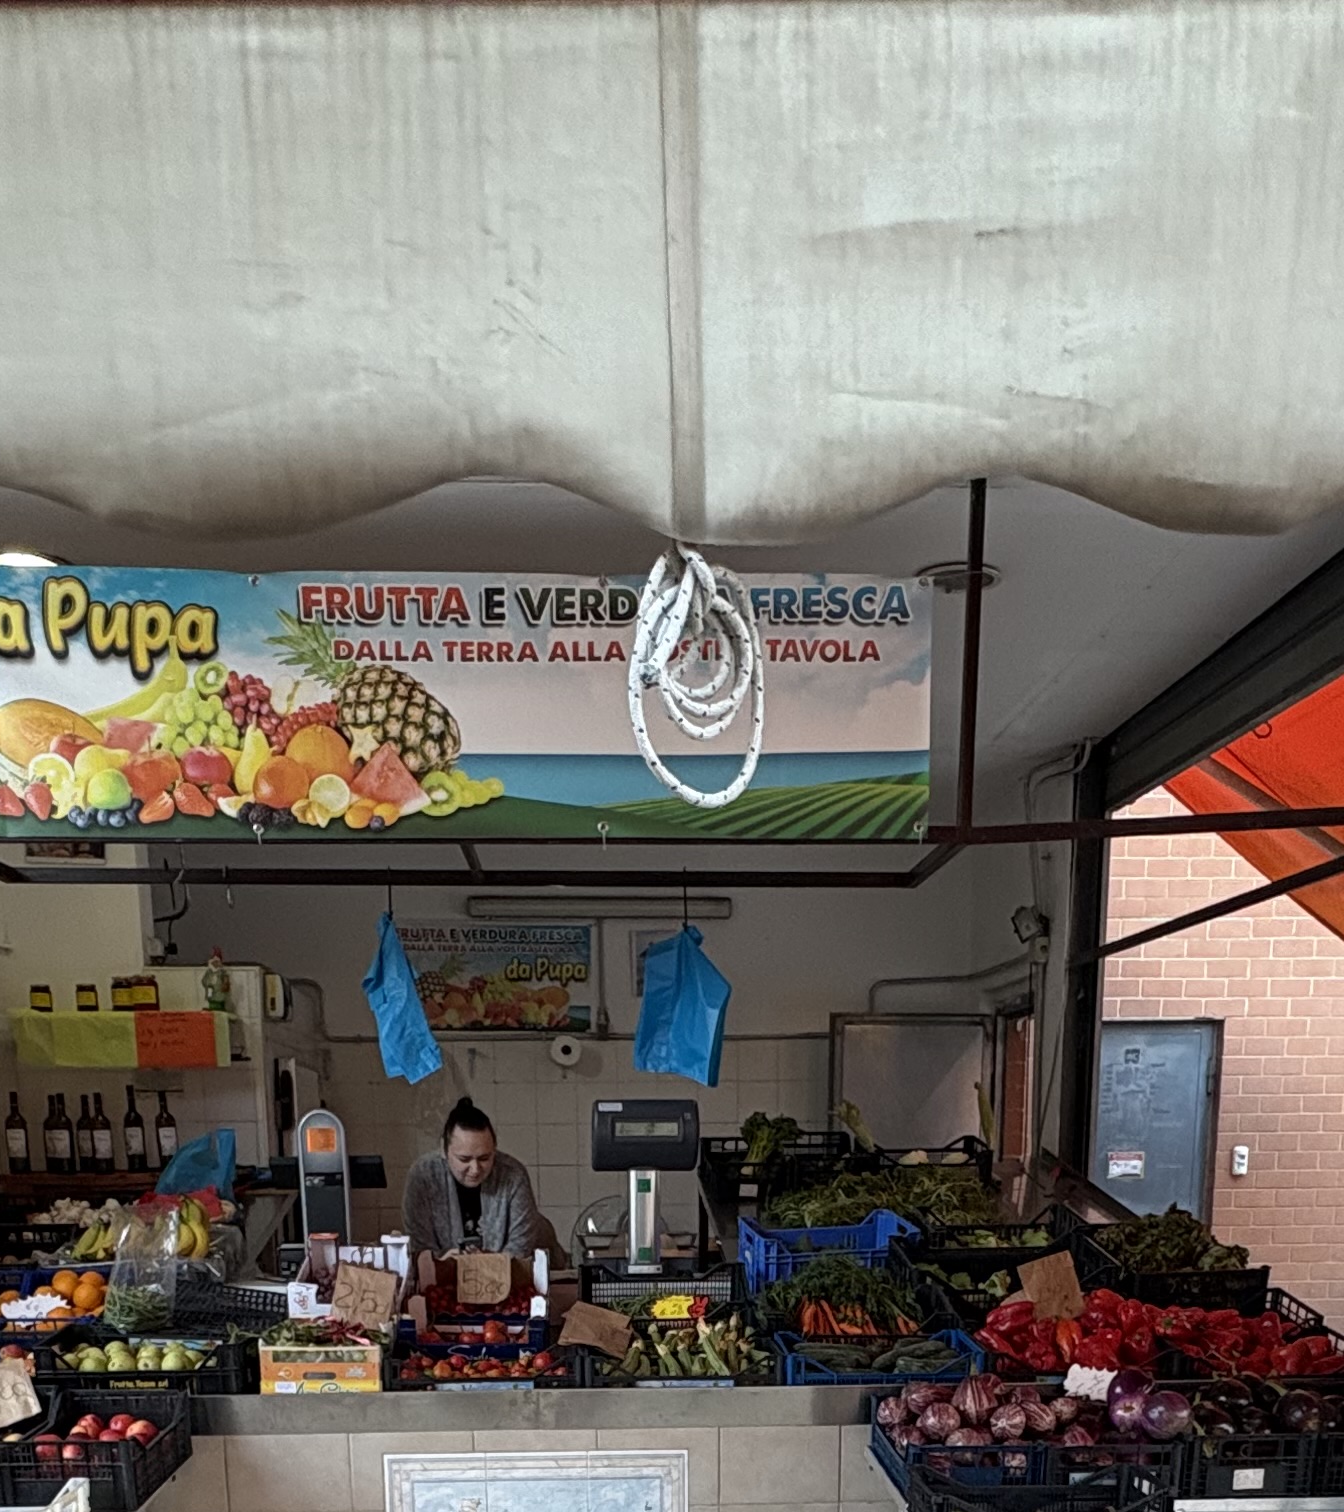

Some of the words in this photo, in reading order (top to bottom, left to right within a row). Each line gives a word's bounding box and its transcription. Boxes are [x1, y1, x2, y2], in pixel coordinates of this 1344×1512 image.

[299, 584, 472, 623] FRUTTA
[482, 585, 507, 623] E
[519, 585, 733, 624] VERD
[750, 584, 911, 623] FRESCA
[42, 576, 219, 680] Pupa
[332, 640, 433, 662] DALLA
[442, 640, 540, 662] TERRA
[548, 640, 626, 662] ALLA
[765, 639, 882, 662] TAVOLA
[450, 928, 461, 941] E
[461, 928, 528, 942] VERDURA
[532, 928, 584, 943] FRESCA
[506, 957, 532, 980] da
[536, 956, 587, 987] Pupa
